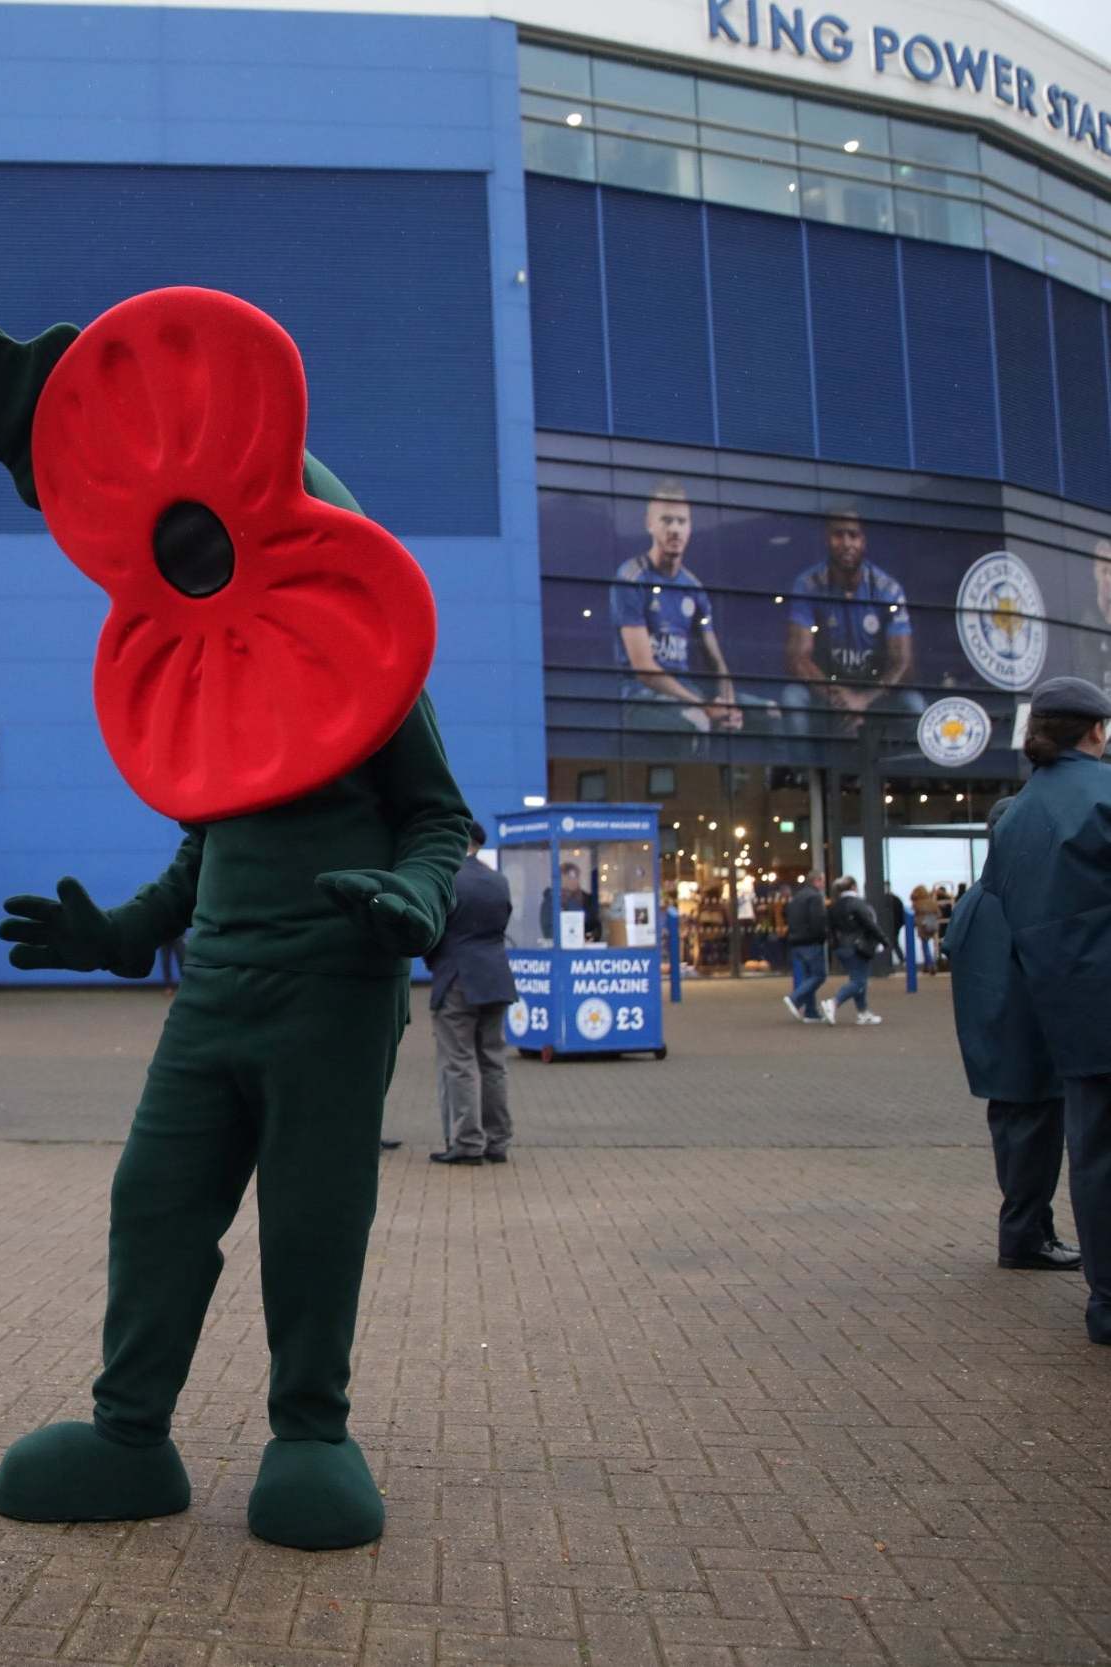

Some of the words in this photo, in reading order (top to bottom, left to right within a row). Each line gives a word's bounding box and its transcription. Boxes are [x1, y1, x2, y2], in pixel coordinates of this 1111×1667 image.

[709, 0, 853, 63] KING
[873, 26, 1037, 117] POWER
[571, 959, 650, 975] MATCHDAY
[515, 979, 550, 995] AGAZINE
[573, 979, 649, 995] MAGAZINE
[531, 1006, 549, 1031] £3
[616, 1006, 645, 1031] £3
